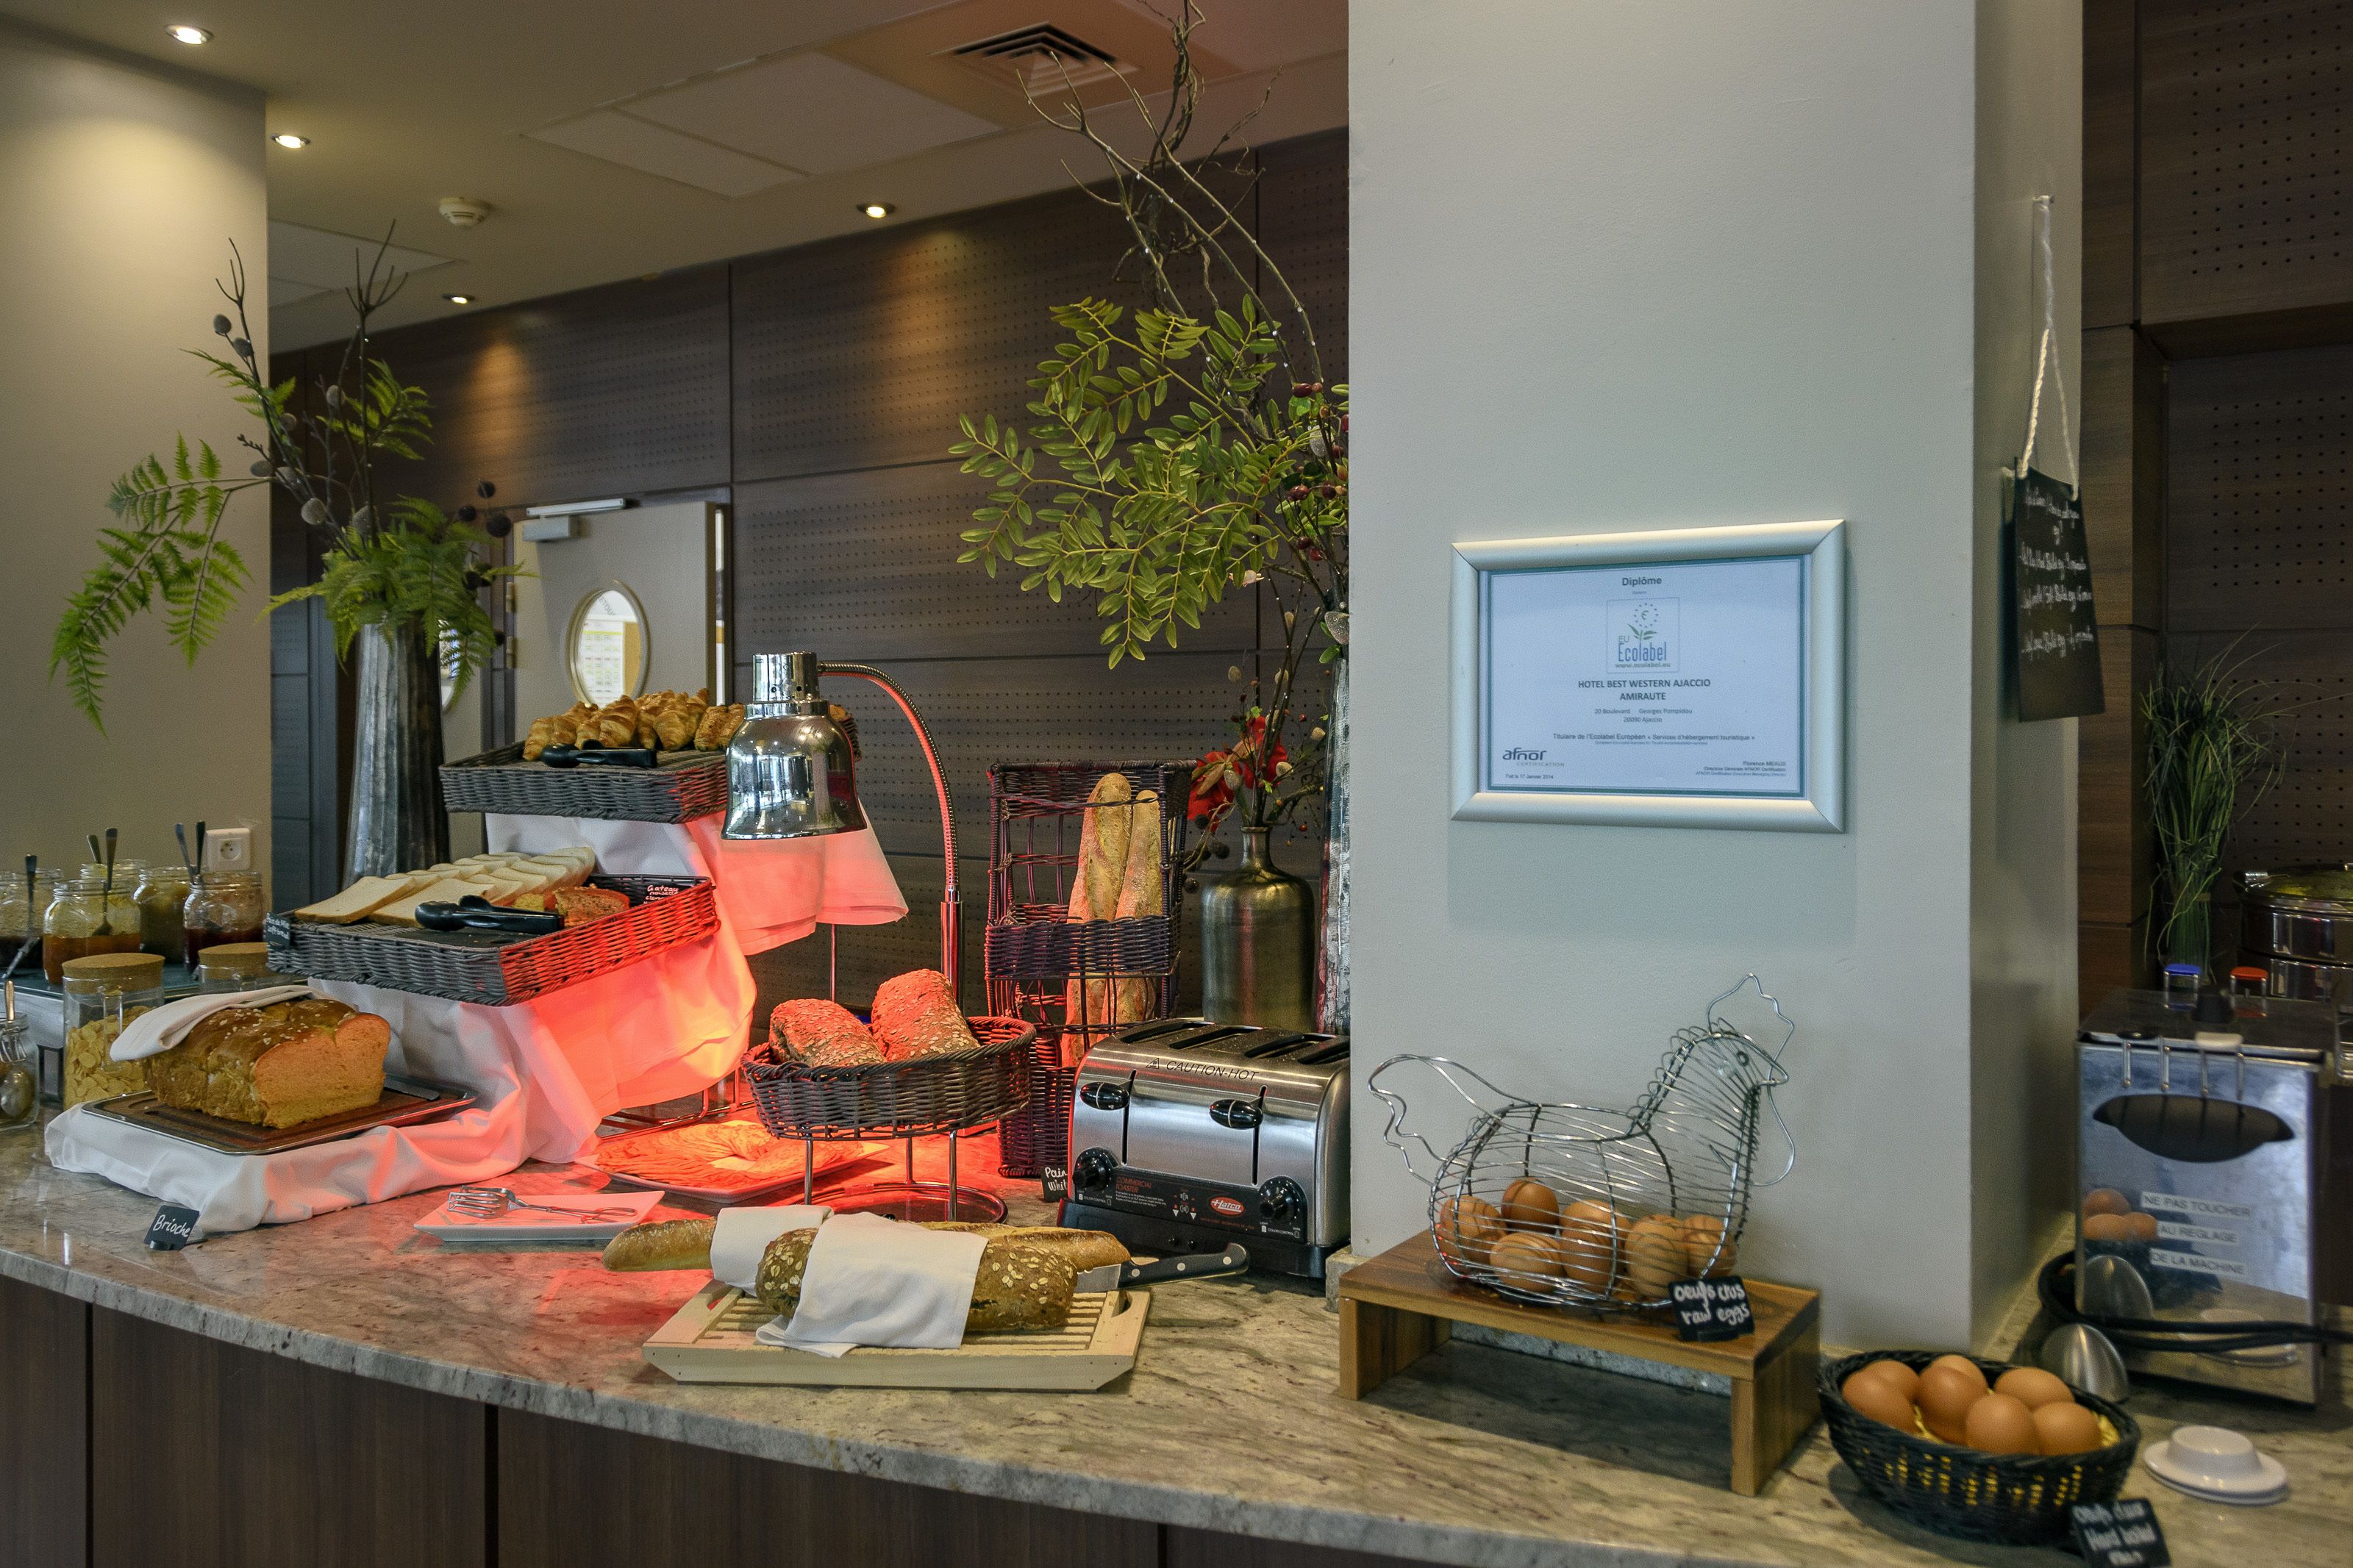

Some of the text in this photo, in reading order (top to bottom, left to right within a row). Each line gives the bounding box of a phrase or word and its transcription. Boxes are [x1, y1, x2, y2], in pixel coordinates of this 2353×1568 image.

[1622, 577, 1662, 587] Diplôme
[1618, 642, 1667, 662] Ecolabel
[1578, 679, 1710, 688] HOTEL BEST WESTERN AJACCIO
[1620, 692, 1666, 701] AMIRAUTE
[1502, 747, 1547, 760] afnor
[1166, 1060, 1260, 1081] CAUTION-HOT
[1045, 1167, 1068, 1178] Pain
[1048, 1179, 1068, 1191] Whit
[1212, 1199, 1242, 1213] Hatco
[2144, 1195, 2252, 1217] NE PAS TOUCHER
[152, 1214, 191, 1238] Brioche
[2162, 1225, 2176, 1235] AU
[2152, 1252, 2246, 1276] DE LA MACHINE
[1716, 1303, 1750, 1326] eggs
